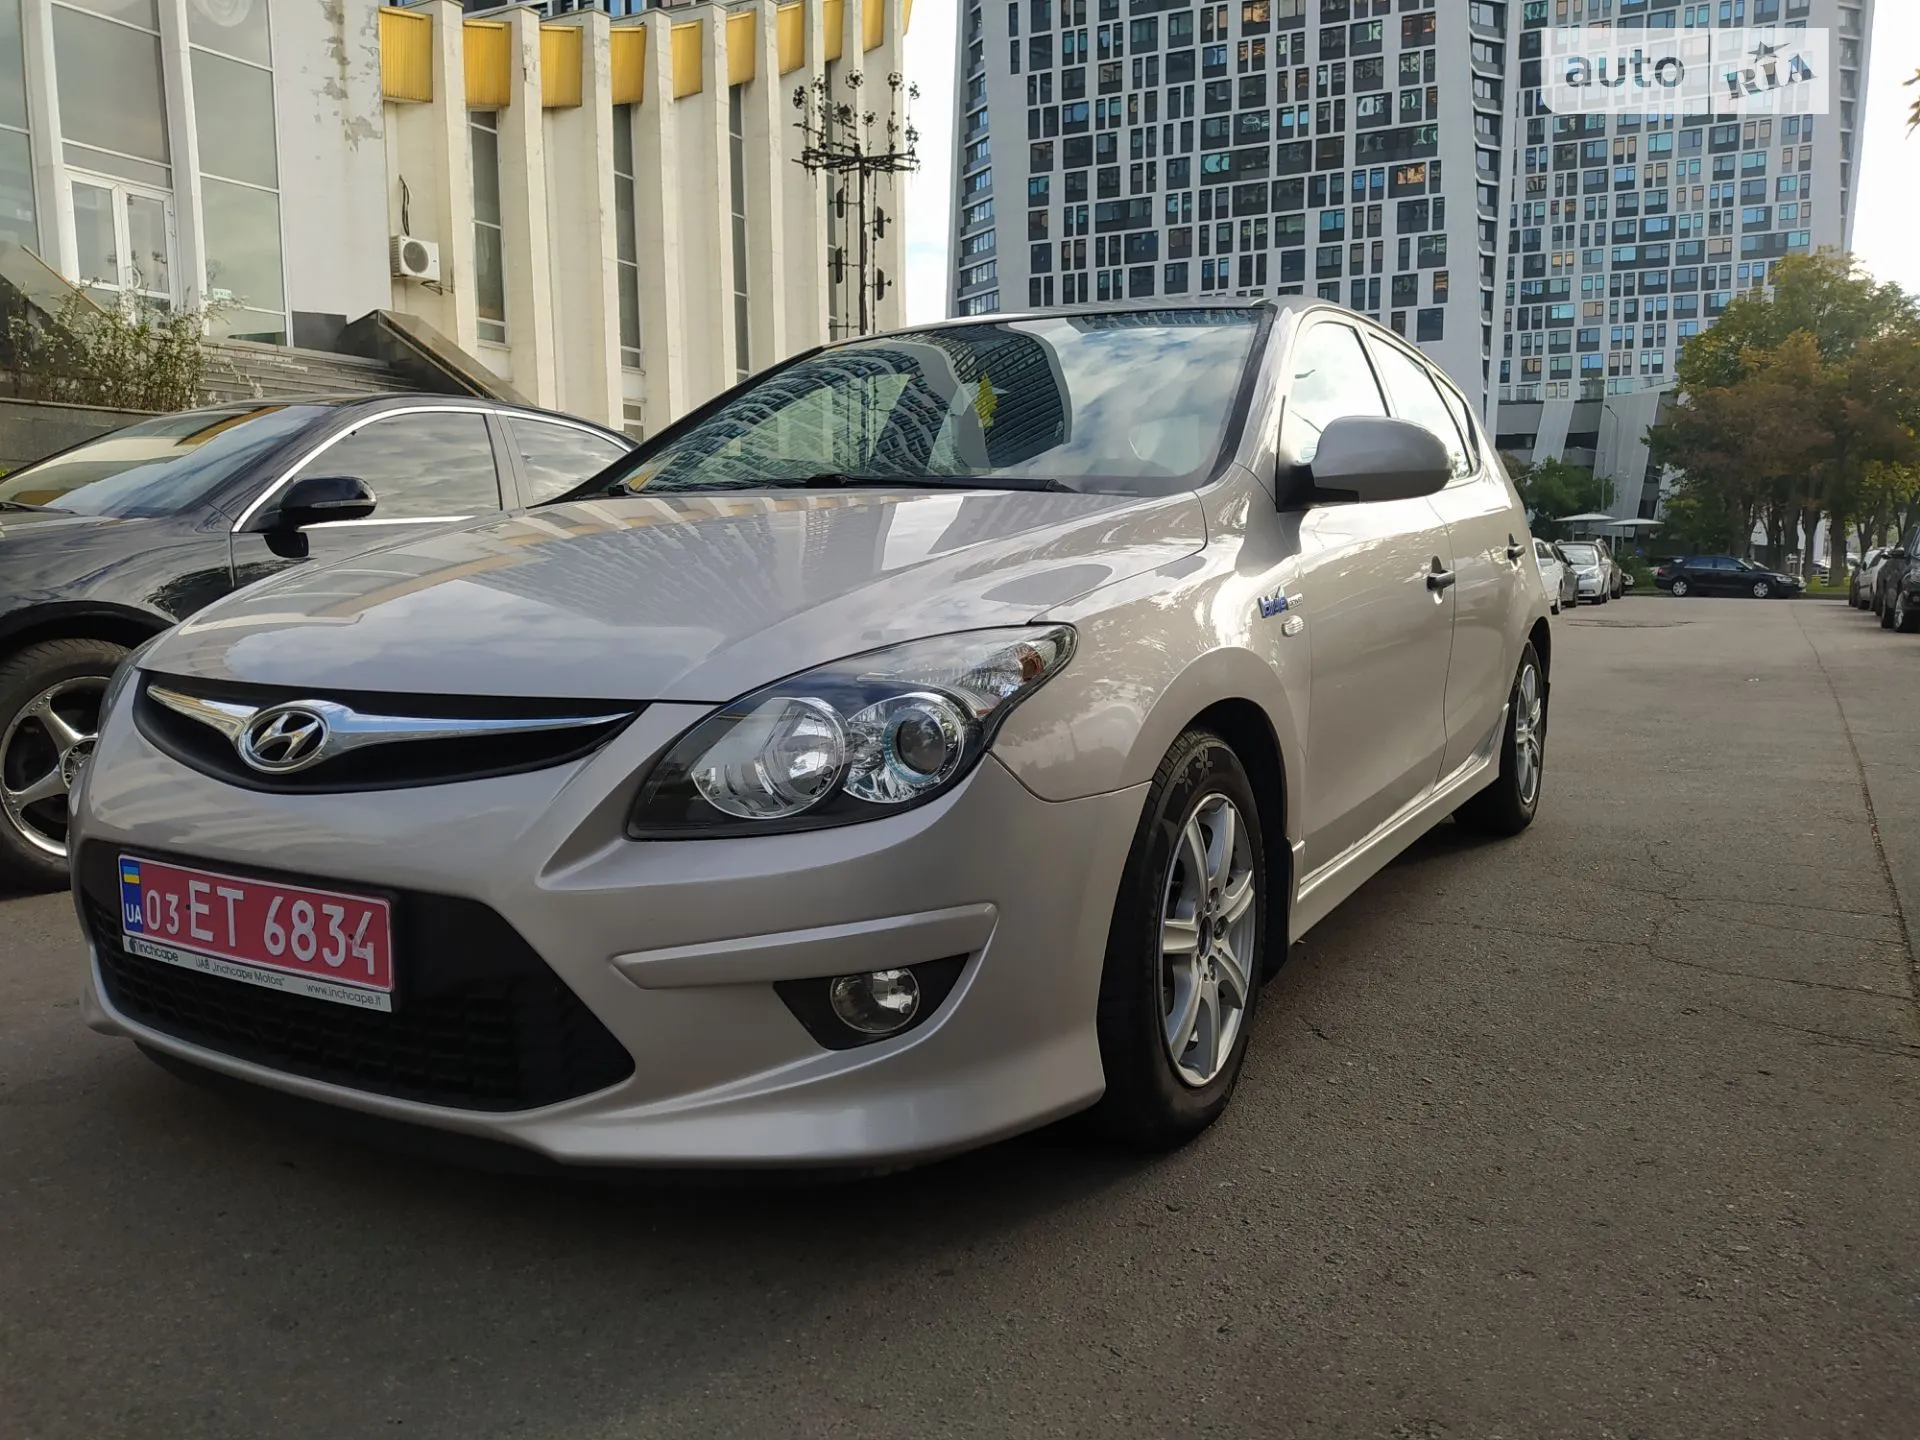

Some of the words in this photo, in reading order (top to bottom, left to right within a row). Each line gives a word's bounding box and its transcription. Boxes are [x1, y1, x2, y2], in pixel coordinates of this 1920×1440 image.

[126, 903, 143, 924] UA
[146, 889, 180, 935] 03
[188, 880, 244, 947] ET
[263, 896, 376, 975] 6834
